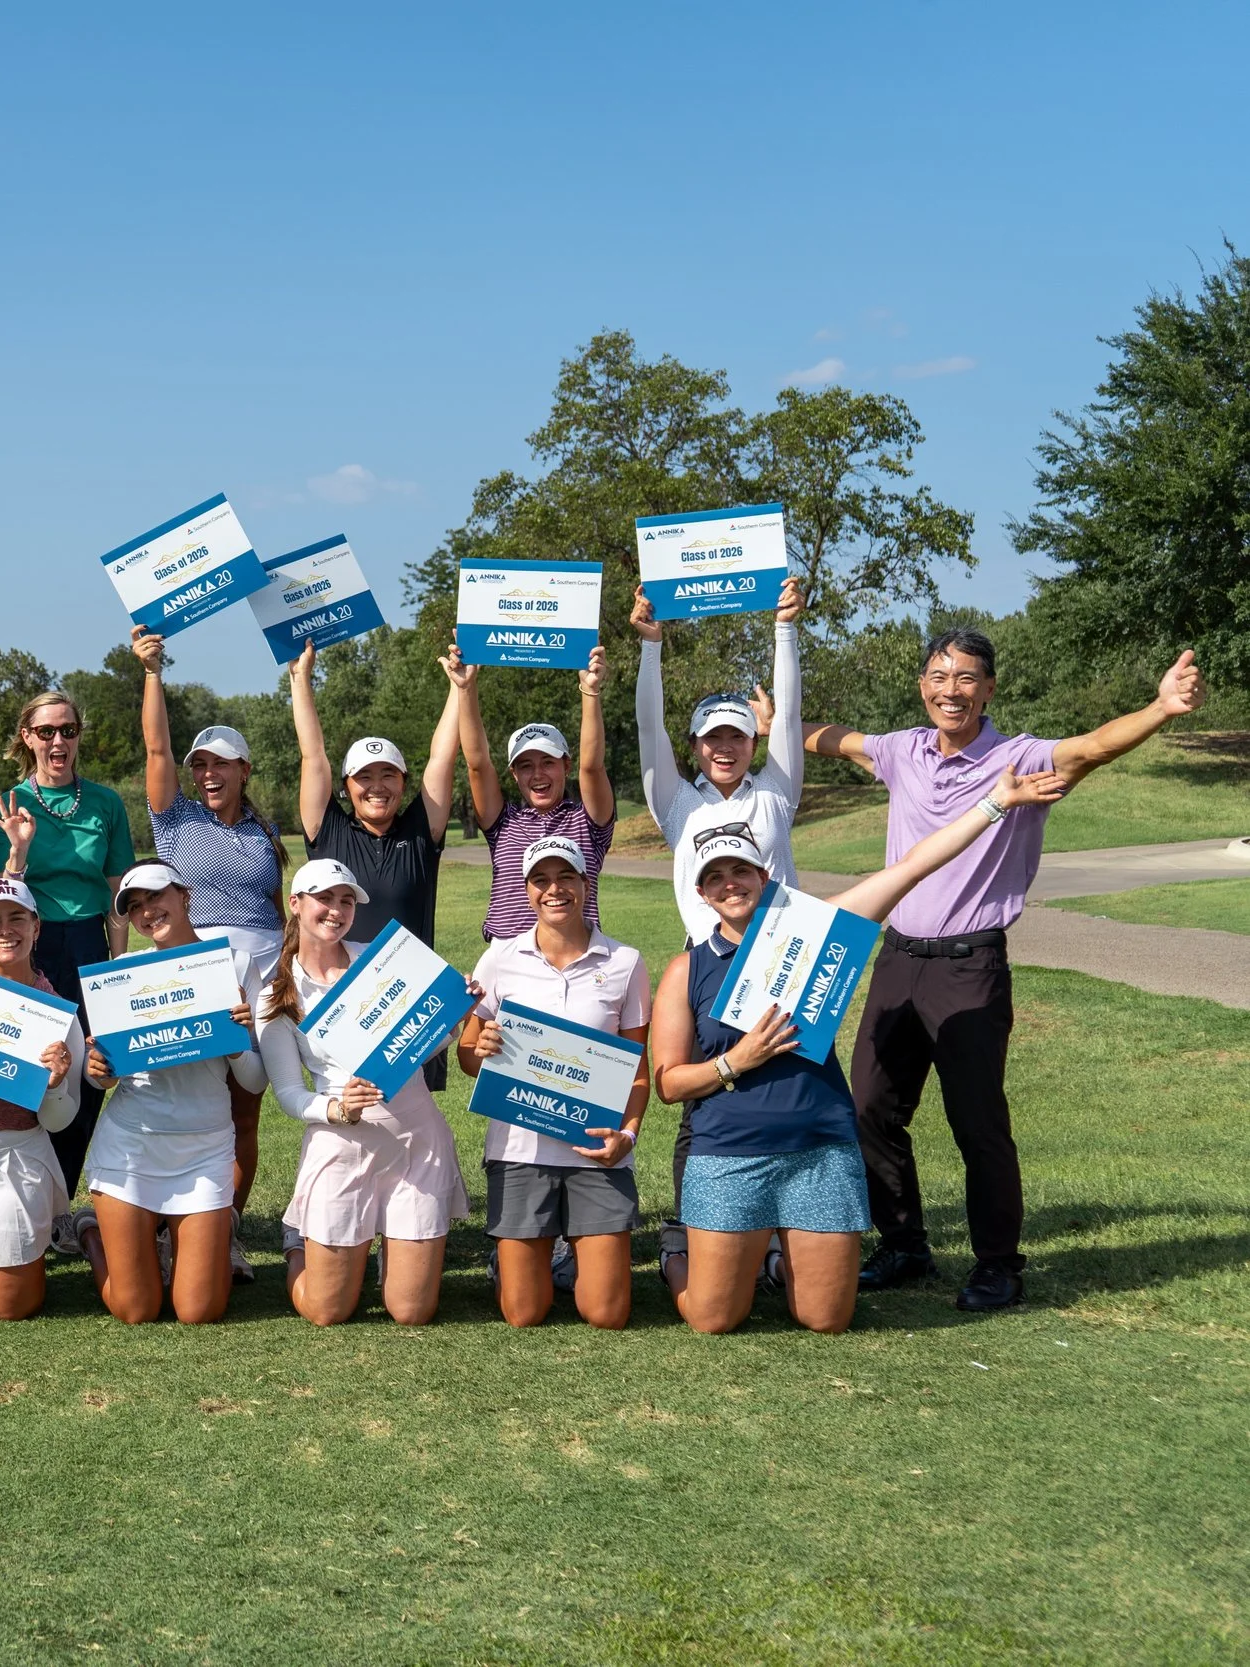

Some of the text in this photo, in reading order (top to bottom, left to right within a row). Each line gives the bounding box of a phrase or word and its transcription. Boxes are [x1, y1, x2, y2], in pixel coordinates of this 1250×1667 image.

[154, 546, 209, 581] Class of 2026
[681, 546, 743, 562] Class of 2026
[163, 580, 217, 615] ANNIKA
[215, 570, 232, 586] 20
[283, 579, 332, 604] Class of 2026
[674, 576, 756, 597] ANNIKA 20
[498, 599, 558, 612] Class of 2026
[292, 604, 352, 637] ANNIKA 20
[486, 631, 566, 647] ANNIKA 20
[701, 840, 741, 859] ping
[103, 974, 131, 984] ANNIKA
[769, 936, 804, 998] Class of 2026
[801, 964, 837, 1024] ANNIKA
[826, 942, 844, 962] 20
[130, 987, 195, 1011] Class of 2026
[359, 978, 406, 1030] Class of 2026
[325, 1004, 346, 1026] ANNIKA
[128, 1020, 212, 1050] ANNIKA 20
[383, 1012, 430, 1063] ANNIKA
[423, 995, 441, 1014] 20
[415, 1039, 432, 1058] Southern
[429, 1023, 447, 1041] Company
[516, 1022, 543, 1035] ANNIKA
[155, 1050, 201, 1063] Southern Company
[528, 1054, 590, 1083] Class of 2026
[506, 1086, 588, 1122] ANNIKA 20
[524, 1117, 567, 1136] Southern Company
